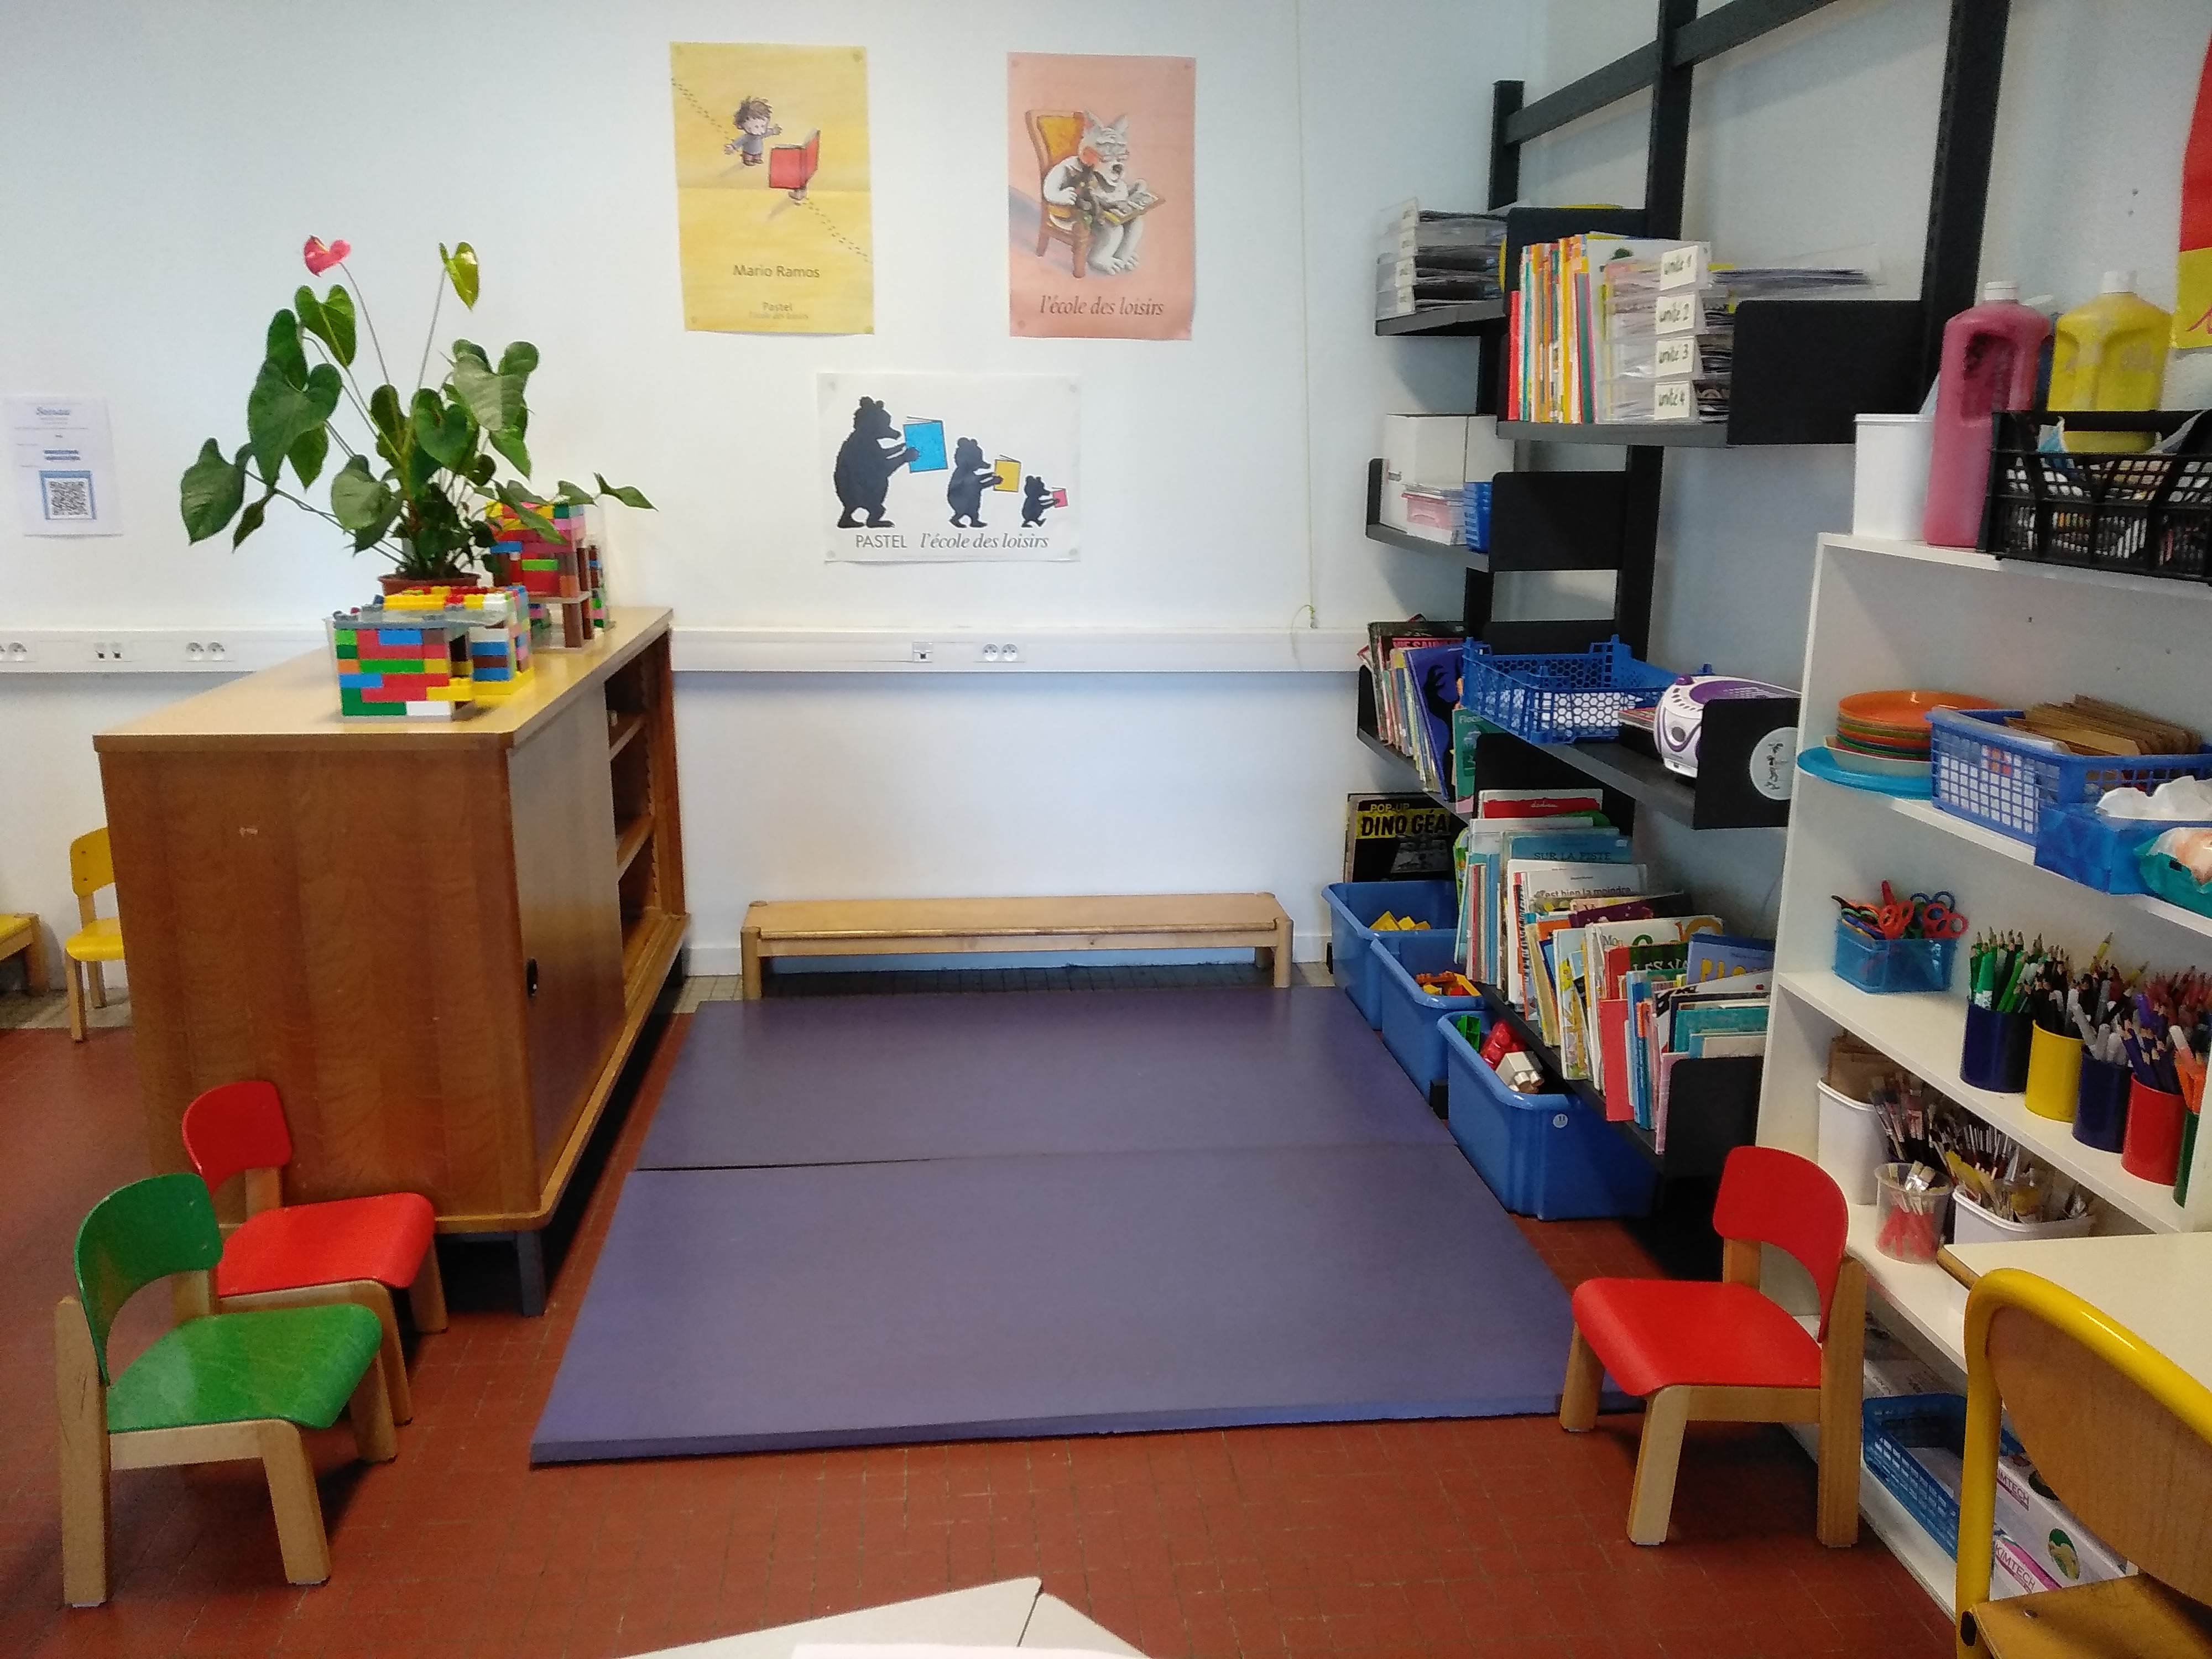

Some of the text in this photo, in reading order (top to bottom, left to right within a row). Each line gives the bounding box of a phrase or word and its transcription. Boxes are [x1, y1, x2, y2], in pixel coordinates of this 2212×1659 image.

[733, 264, 821, 278] Mario Ramos
[763, 302, 792, 311] Pastel
[1040, 294, 1164, 315] l'école des loisirs
[1682, 343, 1688, 360] 3
[855, 533, 1049, 549] PASTEL l'école des loisirs
[1370, 803, 1410, 813] POP-UP
[1361, 809, 1450, 836] DINO GÉA
[1534, 852, 1557, 860] SUR
[1579, 852, 1611, 860] PISTE
[1997, 1469, 2030, 1505] IMTECH
[1995, 1543, 2036, 1591] KIMTECH
